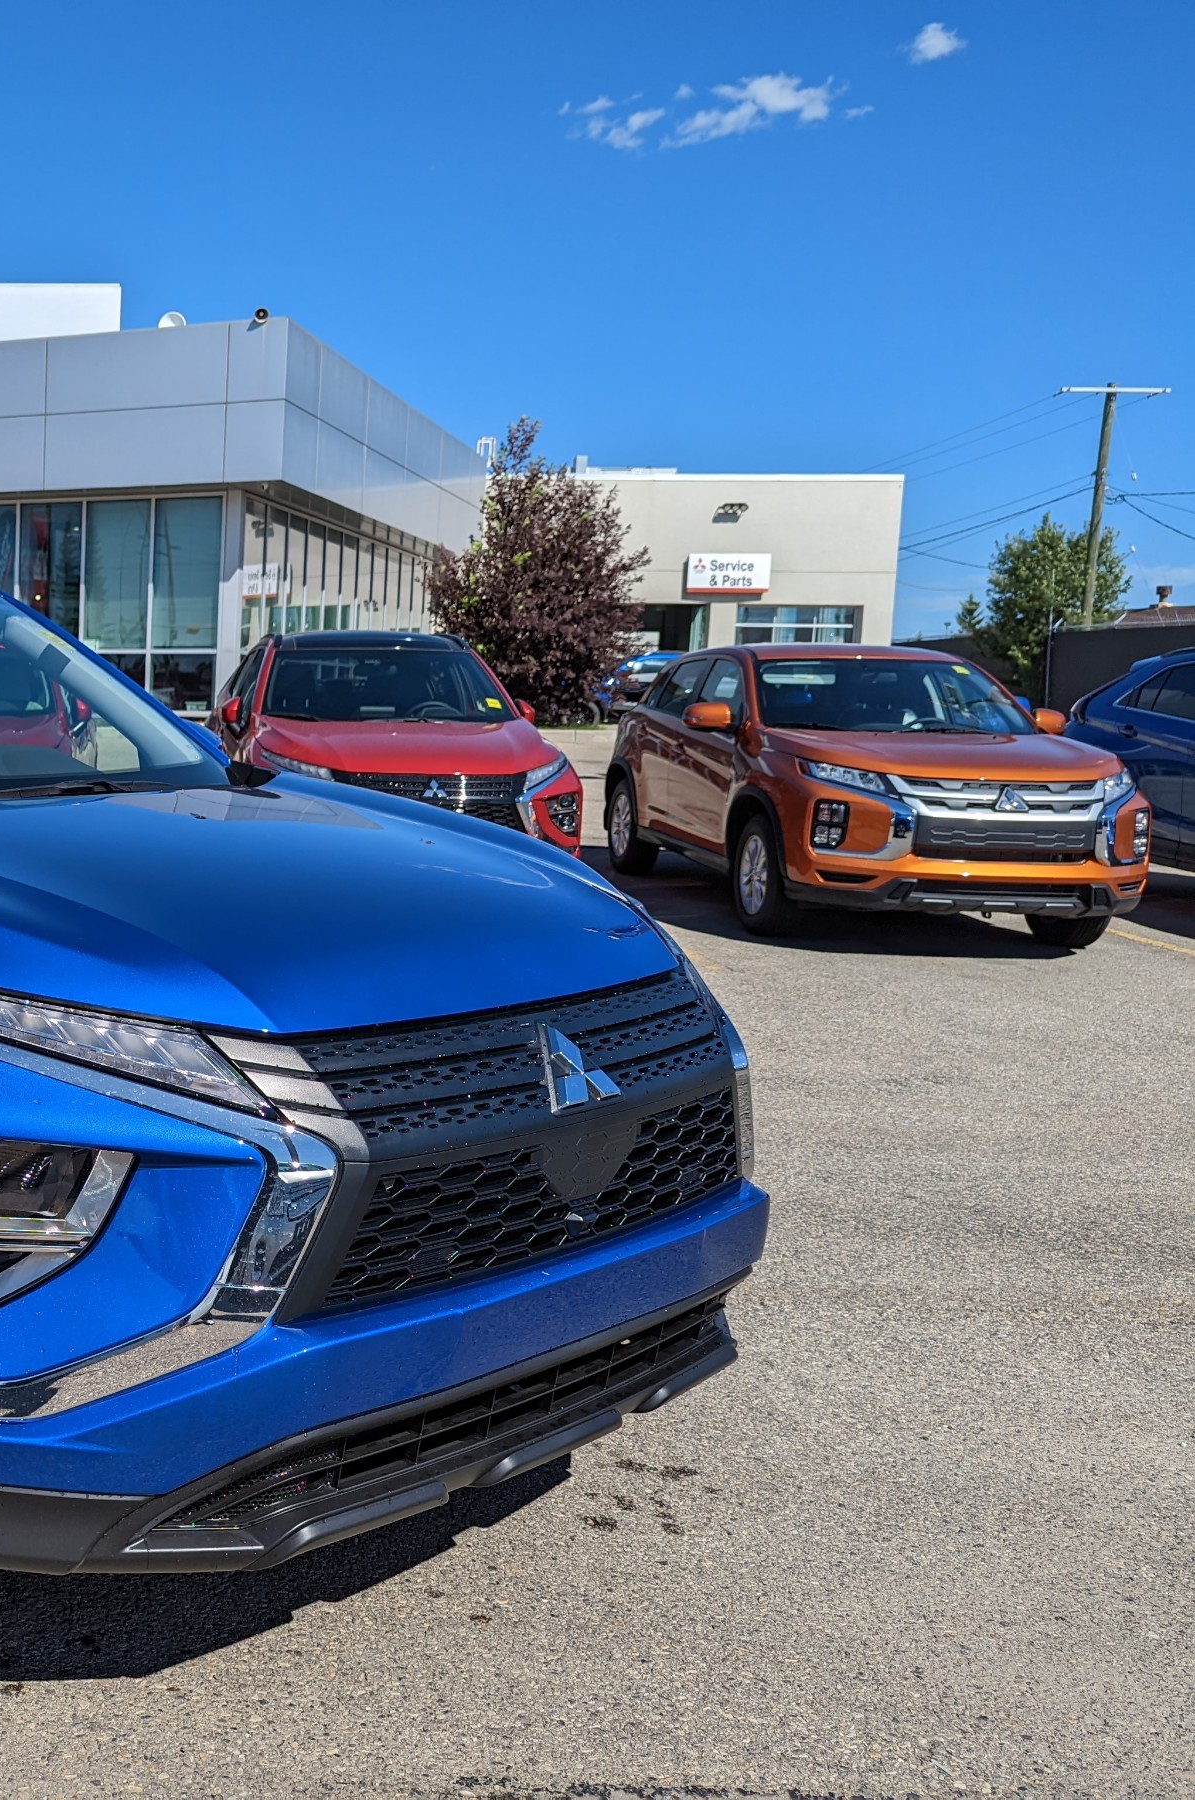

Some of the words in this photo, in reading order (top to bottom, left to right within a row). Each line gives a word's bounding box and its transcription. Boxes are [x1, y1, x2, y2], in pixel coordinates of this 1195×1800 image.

[709, 559, 754, 572] Service
[709, 574, 718, 587] &
[721, 574, 753, 587] Parts
